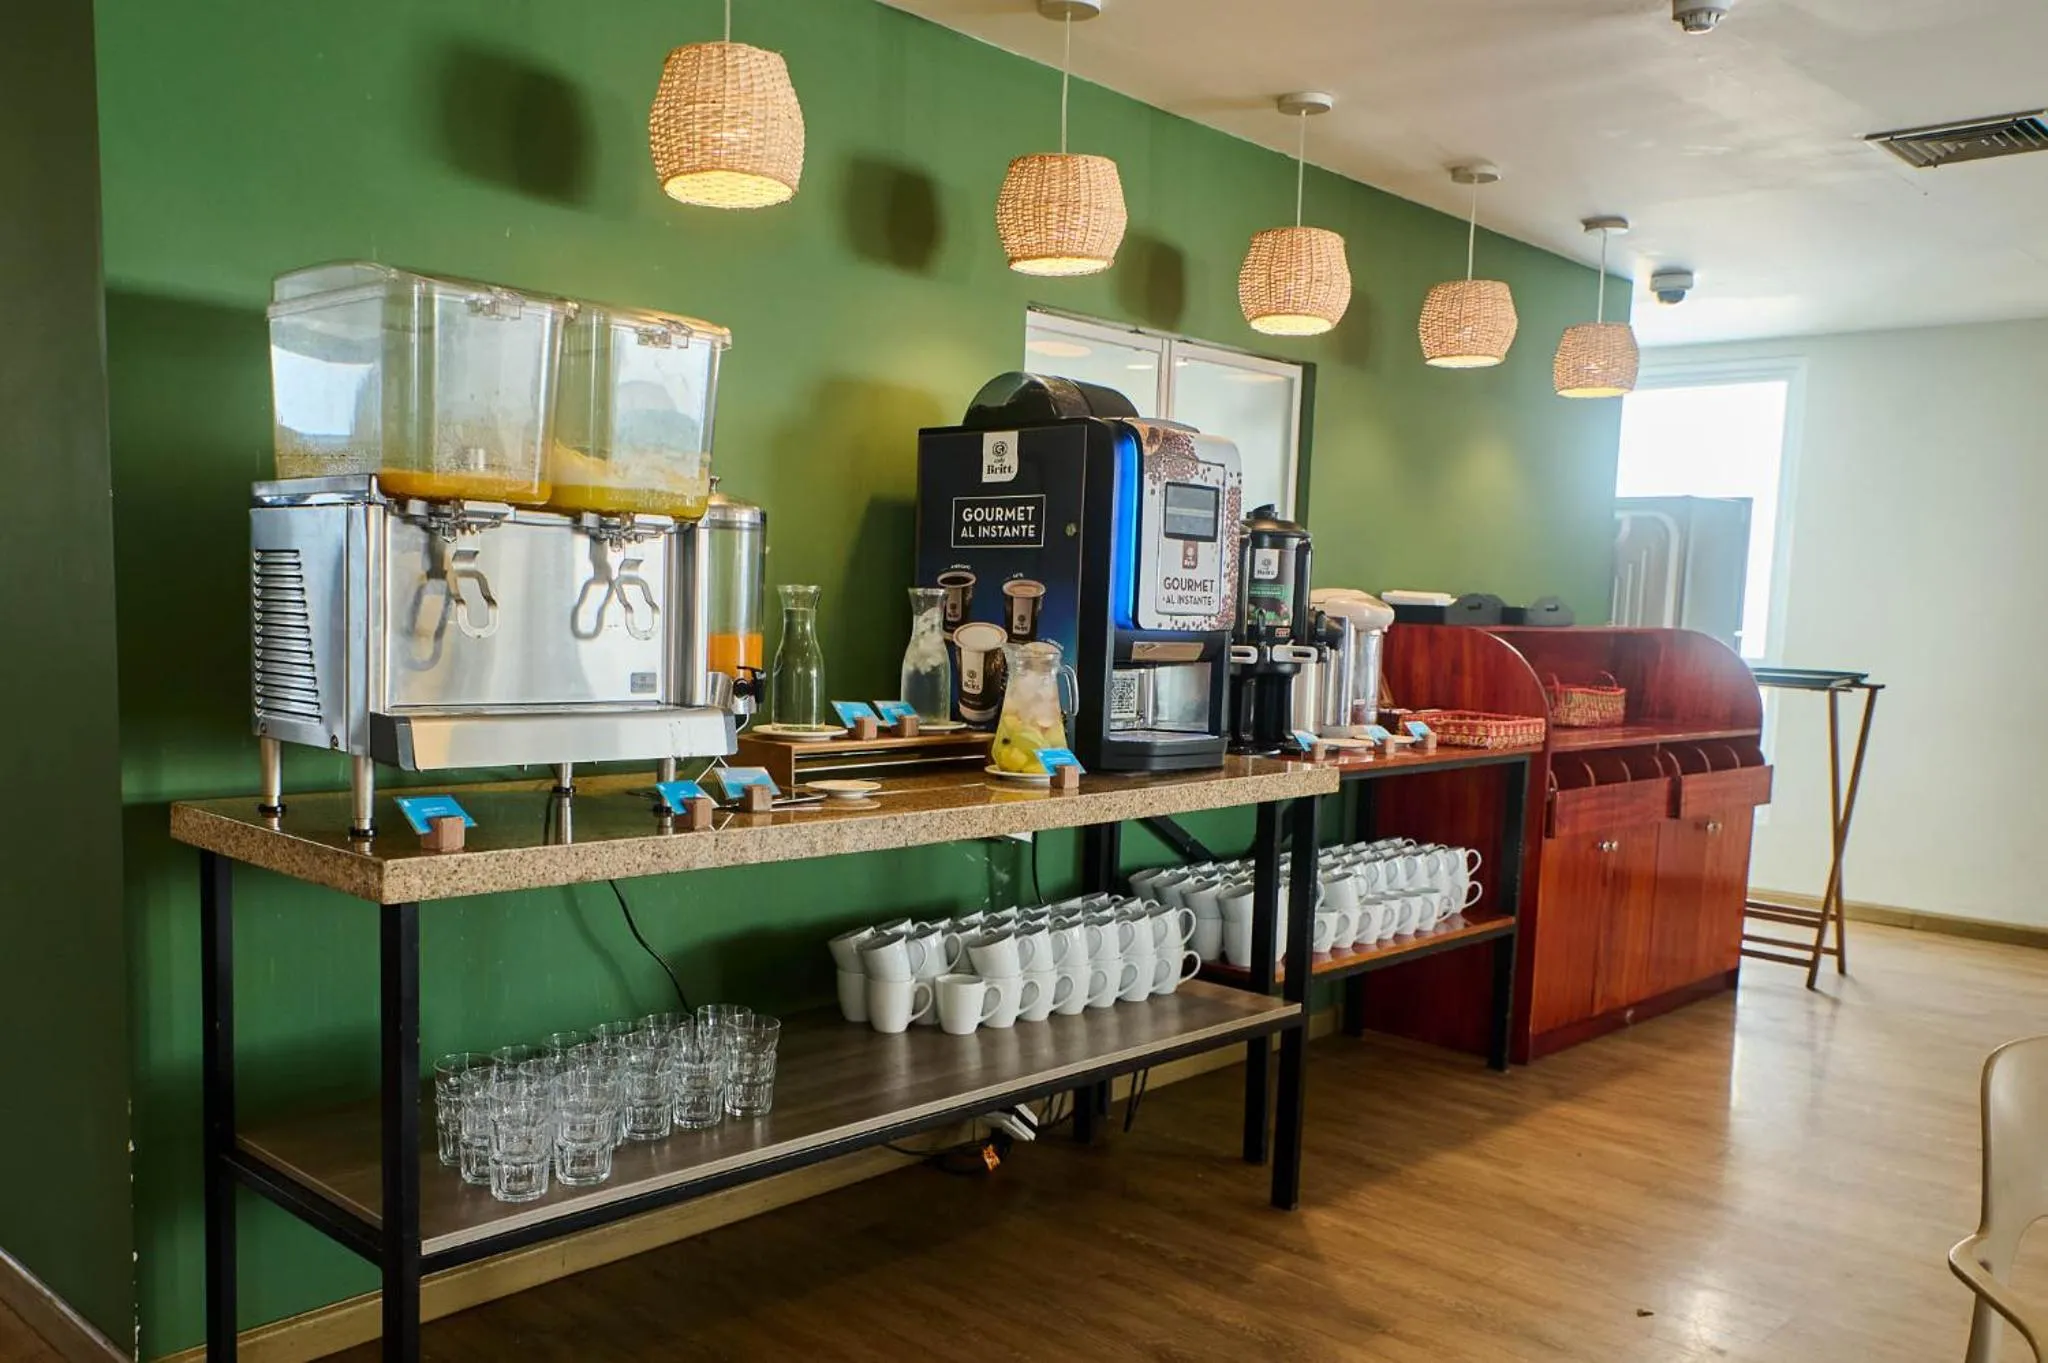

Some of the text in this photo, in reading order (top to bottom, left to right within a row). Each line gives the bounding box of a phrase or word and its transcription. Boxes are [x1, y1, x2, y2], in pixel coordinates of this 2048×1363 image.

[987, 464, 1012, 474] Britt
[963, 506, 1035, 522] GOURMET
[961, 525, 1036, 538] AL INSTANTE
[1164, 577, 1214, 592] GOURMET
[1166, 595, 1212, 606] AL INSTANTE
